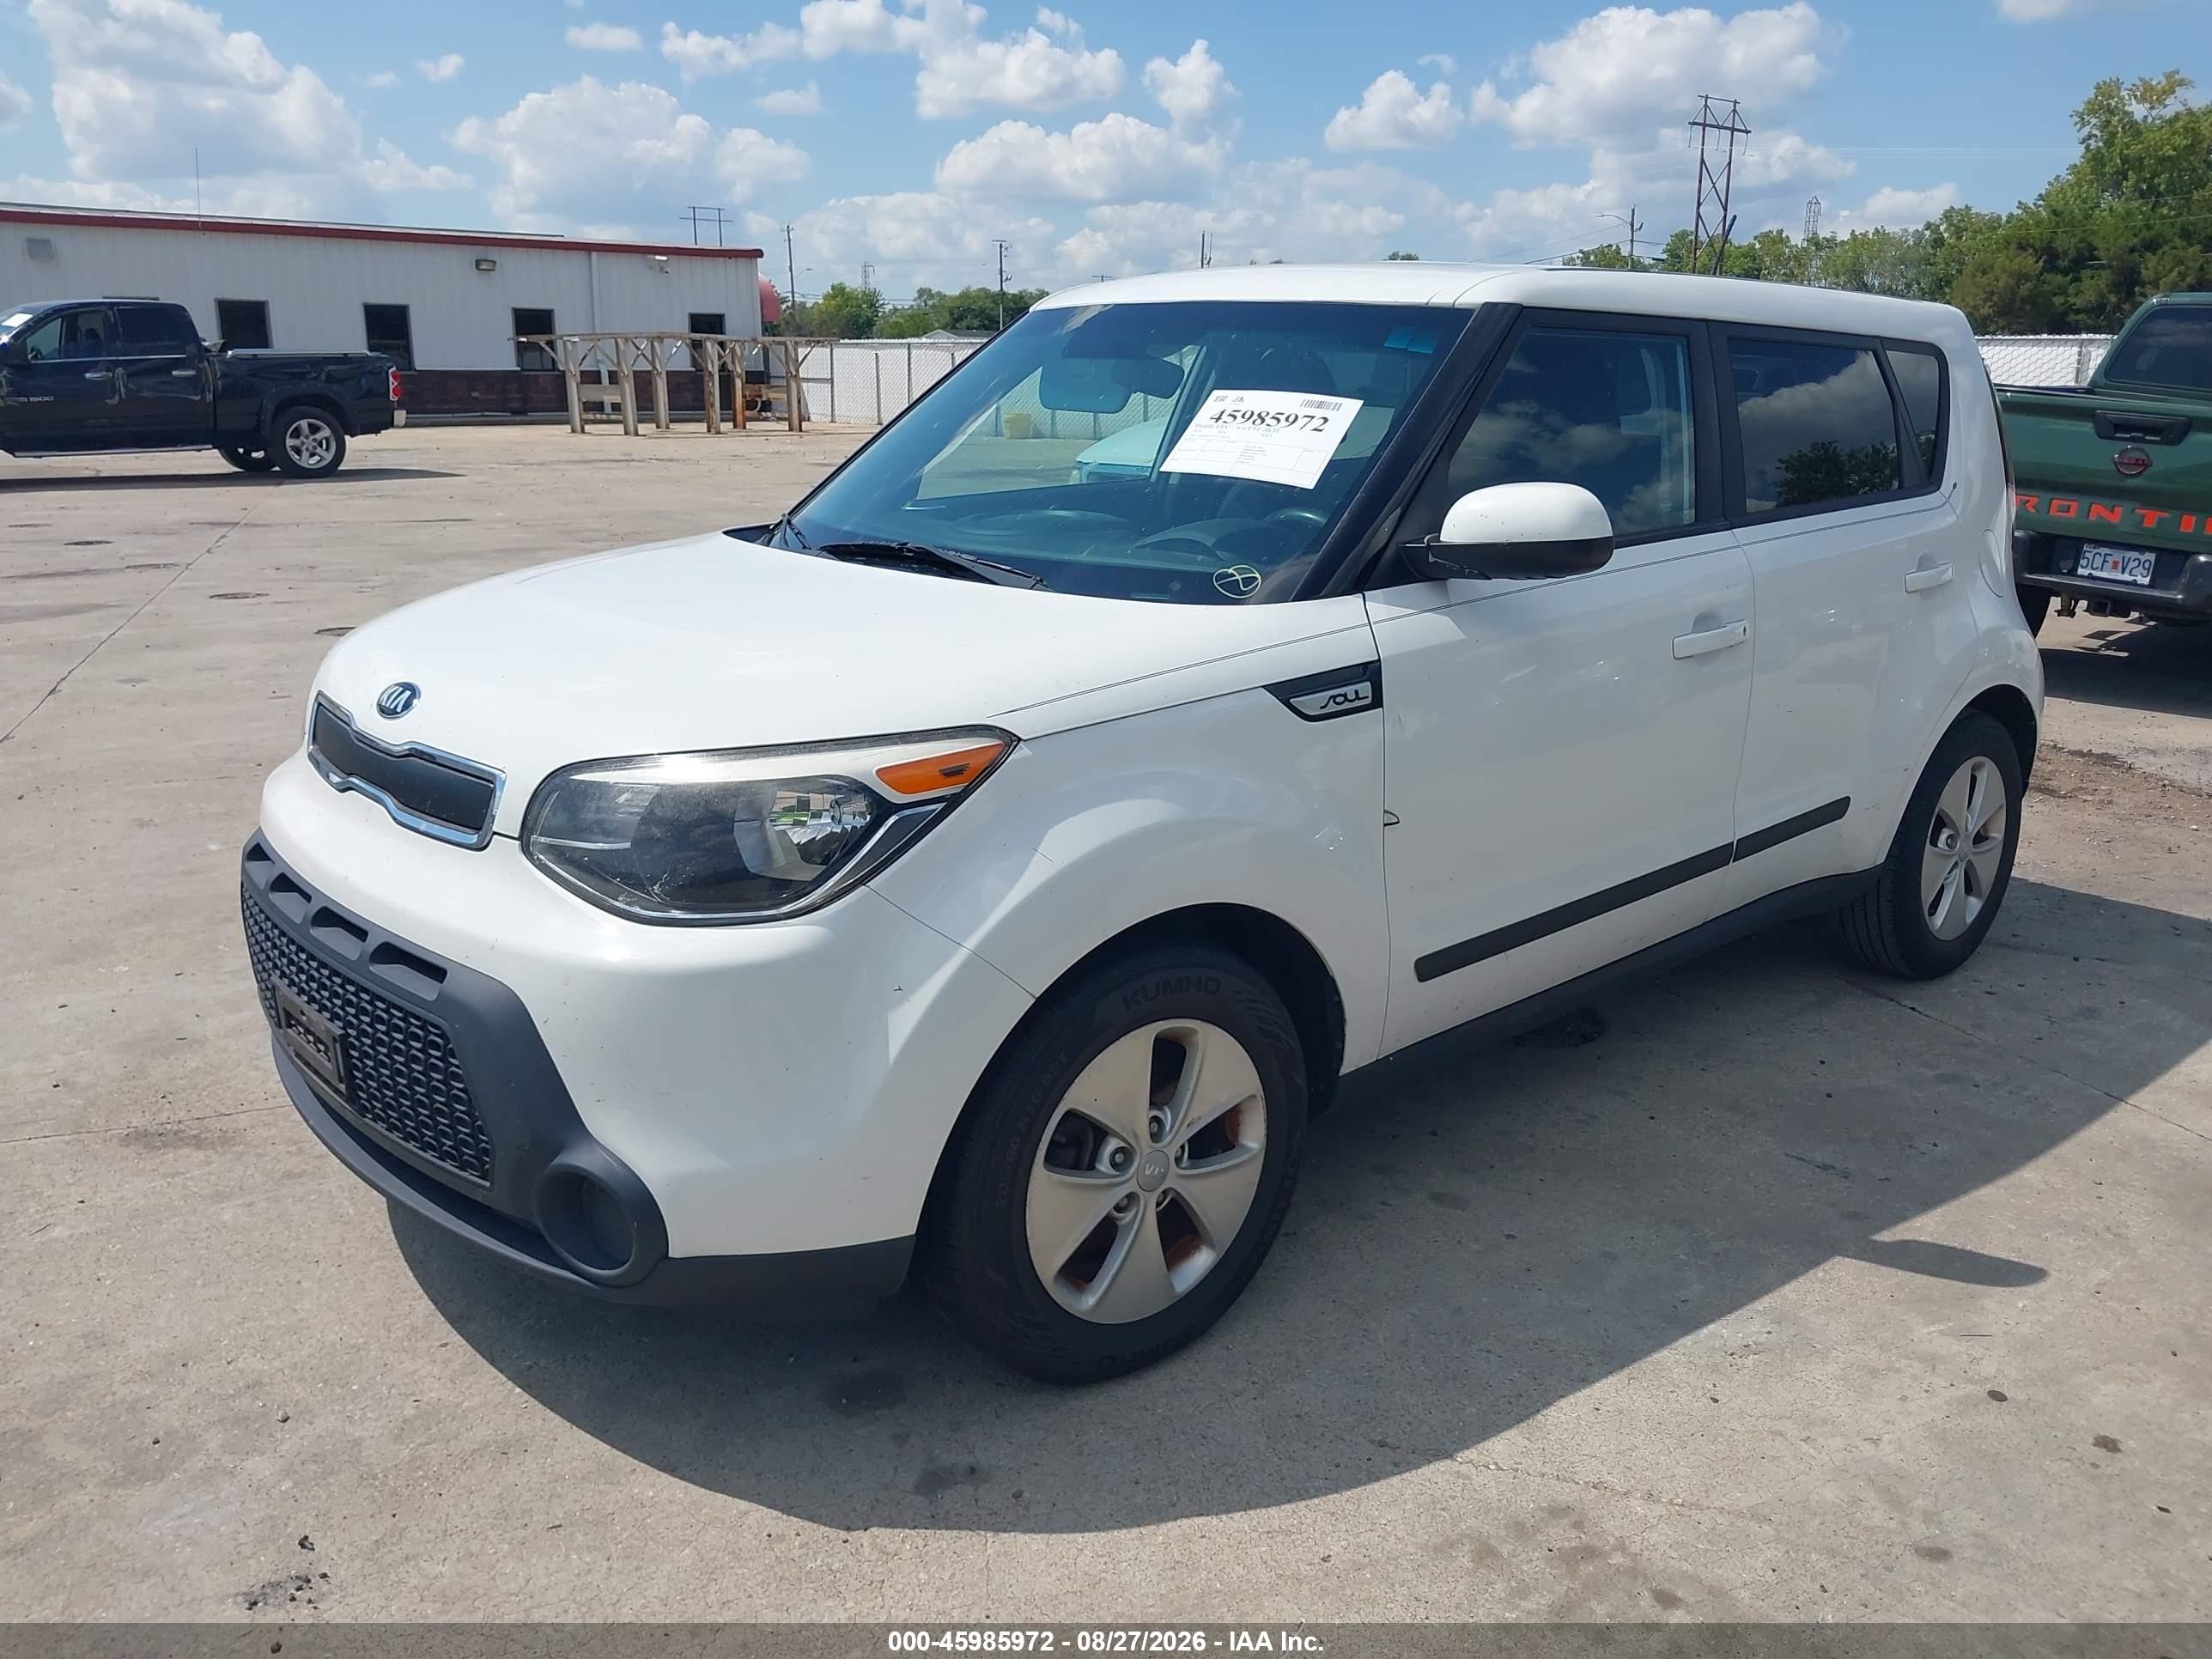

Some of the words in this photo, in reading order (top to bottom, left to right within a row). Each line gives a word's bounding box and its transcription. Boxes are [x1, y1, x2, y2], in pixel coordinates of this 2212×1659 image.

[1209, 409, 1329, 432] 45985972
[2015, 494, 2212, 536] RONTI
[2080, 550, 2112, 571] 5CF
[2120, 556, 2152, 578] V29
[1320, 690, 1369, 709] SOUL
[1121, 975, 1221, 1011] KUMHO
